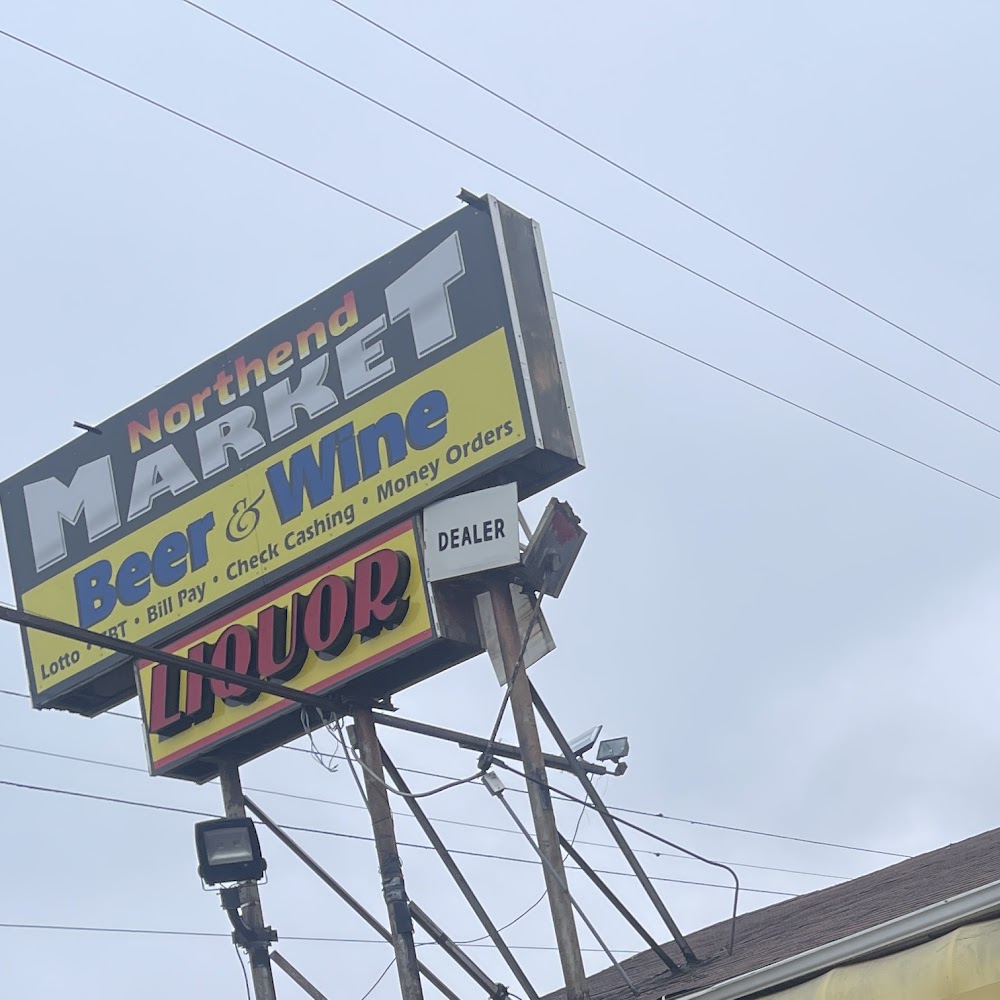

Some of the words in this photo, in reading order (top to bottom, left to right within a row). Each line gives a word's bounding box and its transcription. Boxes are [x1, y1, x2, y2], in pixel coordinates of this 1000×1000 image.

[22, 230, 466, 573] MARKET
[128, 290, 359, 453] Northend
[40, 647, 80, 681] Lotto
[146, 597, 174, 625] Bill
[178, 581, 207, 609] Pay
[226, 541, 280, 582] Check
[283, 503, 355, 551] Cashing
[376, 458, 440, 503] Money
[445, 419, 514, 465] Orders
[73, 511, 216, 629] Beer
[225, 490, 265, 542] &
[265, 389, 449, 526] Wine
[437, 518, 506, 551] DEALER
[150, 548, 408, 735] LIQUOR
